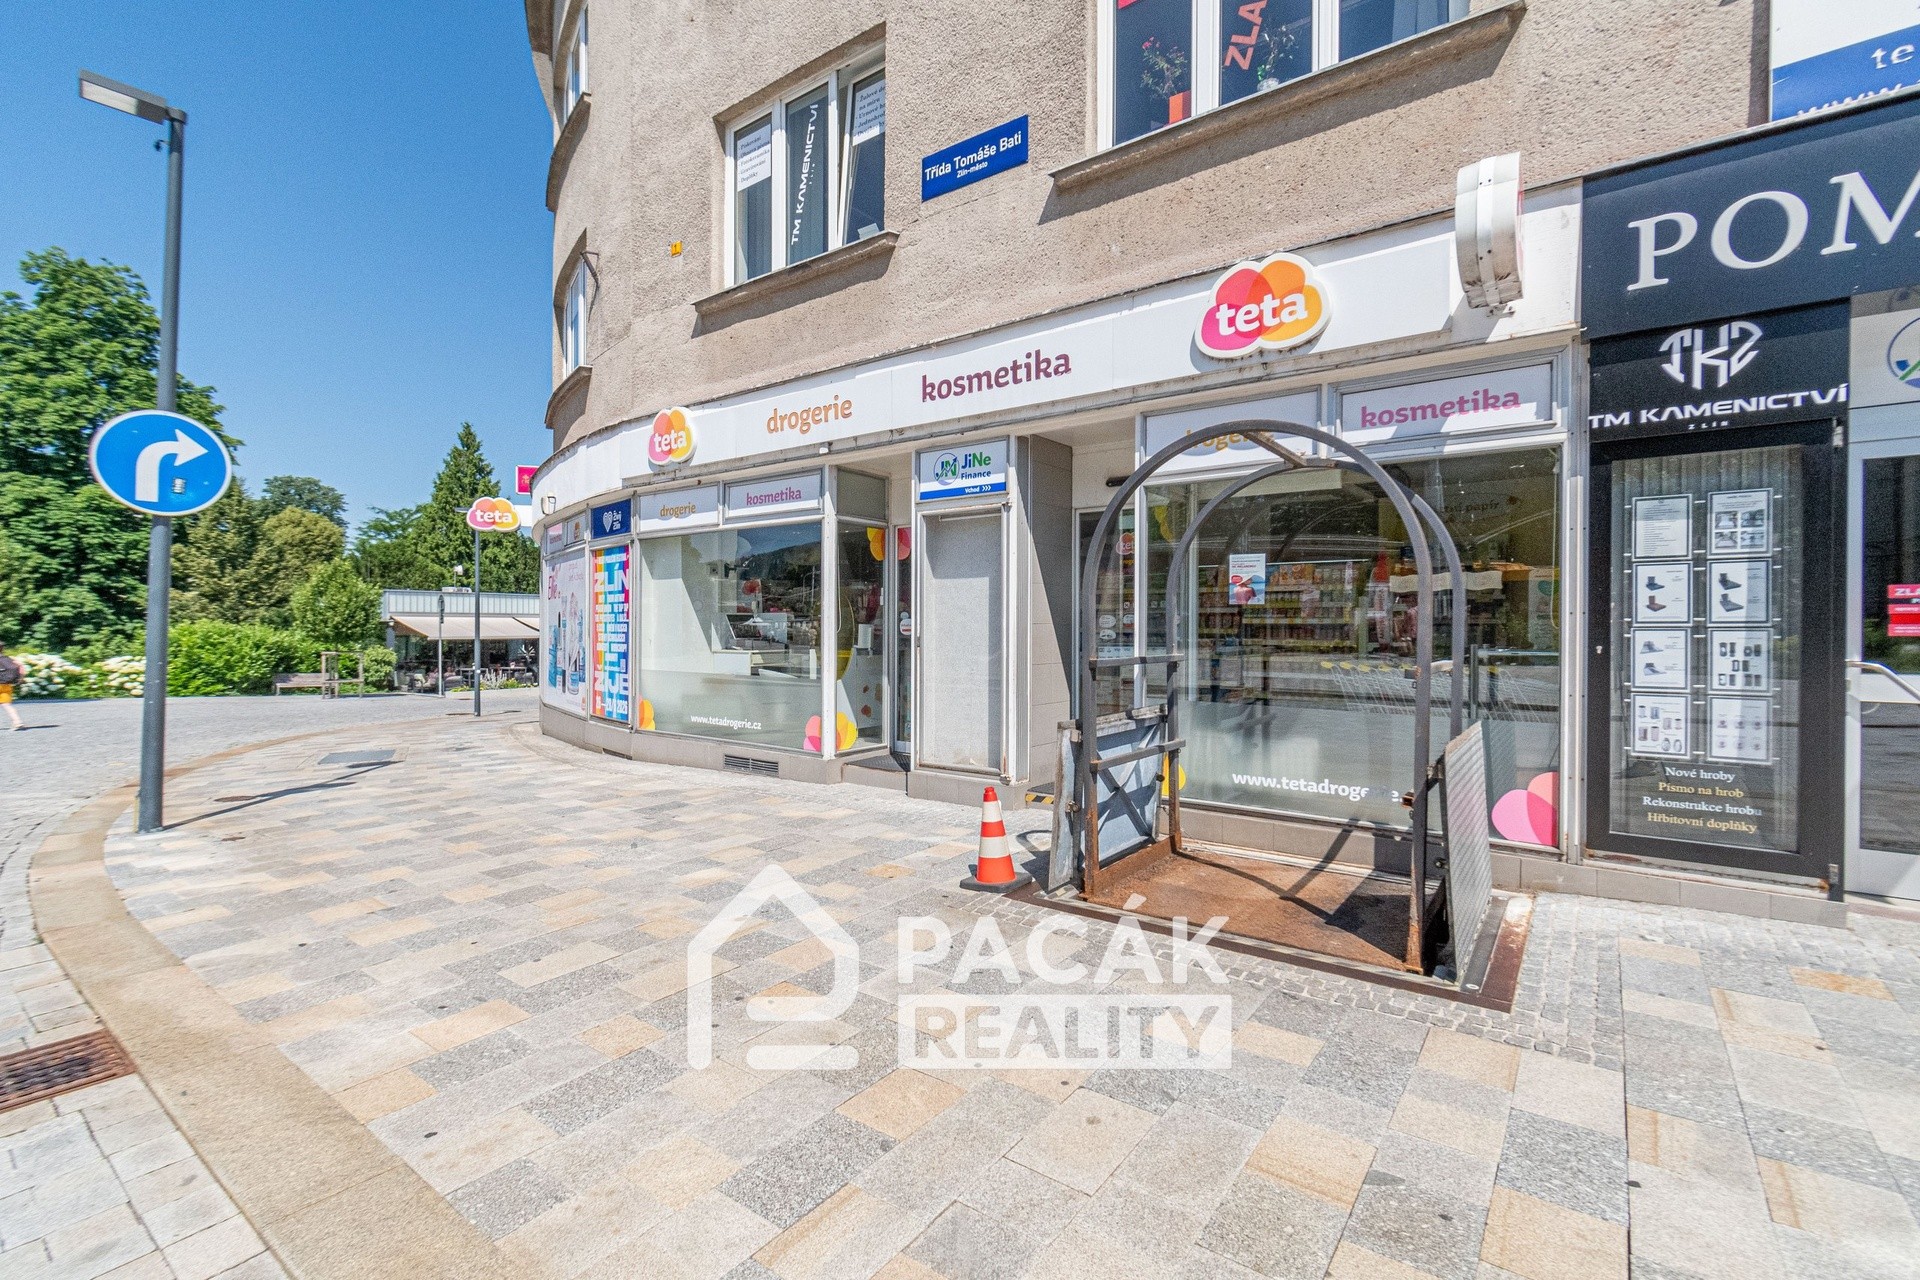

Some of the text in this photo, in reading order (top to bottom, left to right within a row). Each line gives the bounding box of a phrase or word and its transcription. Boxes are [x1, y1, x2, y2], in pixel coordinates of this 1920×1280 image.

[925, 131, 1022, 181] Třída Tomáše Bati
[791, 218, 802, 245] TM
[1627, 171, 1920, 291] POM
[1215, 292, 1308, 336] teta
[921, 349, 1072, 402] kosmetika
[766, 395, 853, 435] drogerie
[1360, 388, 1521, 428] kosmetika
[1588, 383, 1849, 429] TM KAMENICTVÍ
[654, 429, 687, 453] teta
[961, 452, 992, 470] JiNe
[960, 470, 992, 480] Finance
[745, 487, 802, 507] kosmetika
[475, 507, 513, 524] teta
[659, 501, 697, 520] drogerie
[690, 714, 762, 731] www.tetadrogerie.cz
[1665, 766, 1735, 782] Nové hroby
[1698, 786, 1712, 796] na
[1715, 787, 1744, 798] hrob
[1642, 797, 1762, 816] Rekonstrukce hrobu
[1647, 812, 1757, 834] Hřbitovní doplňky
